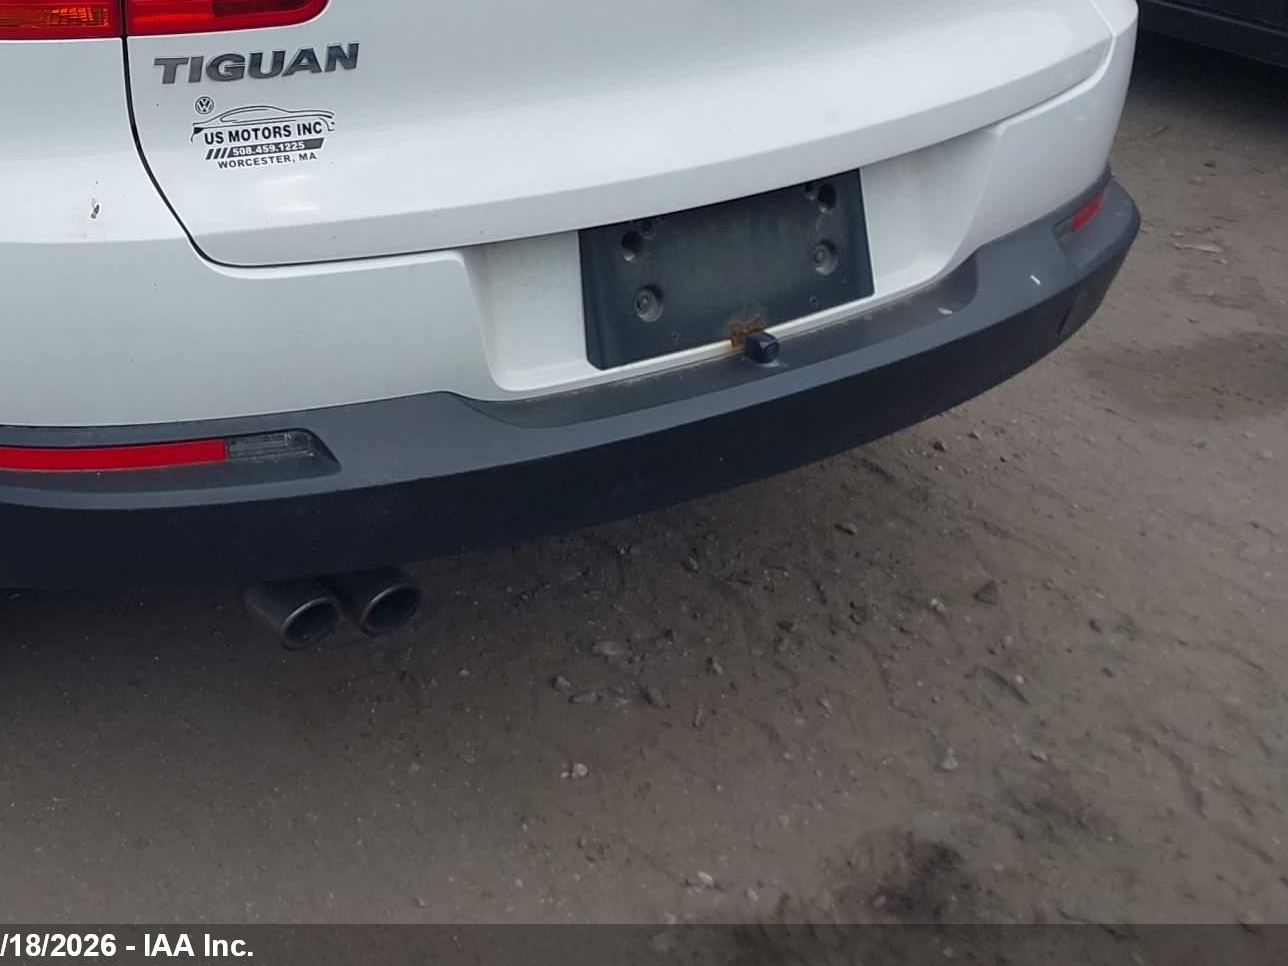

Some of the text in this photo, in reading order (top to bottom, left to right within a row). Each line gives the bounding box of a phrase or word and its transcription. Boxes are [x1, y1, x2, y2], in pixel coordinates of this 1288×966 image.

[153, 42, 360, 85] TIGUAN
[204, 121, 323, 146] US MOTORS INC
[232, 141, 306, 157] 508.459.1225
[217, 151, 317, 170] WORCESTER, MA
